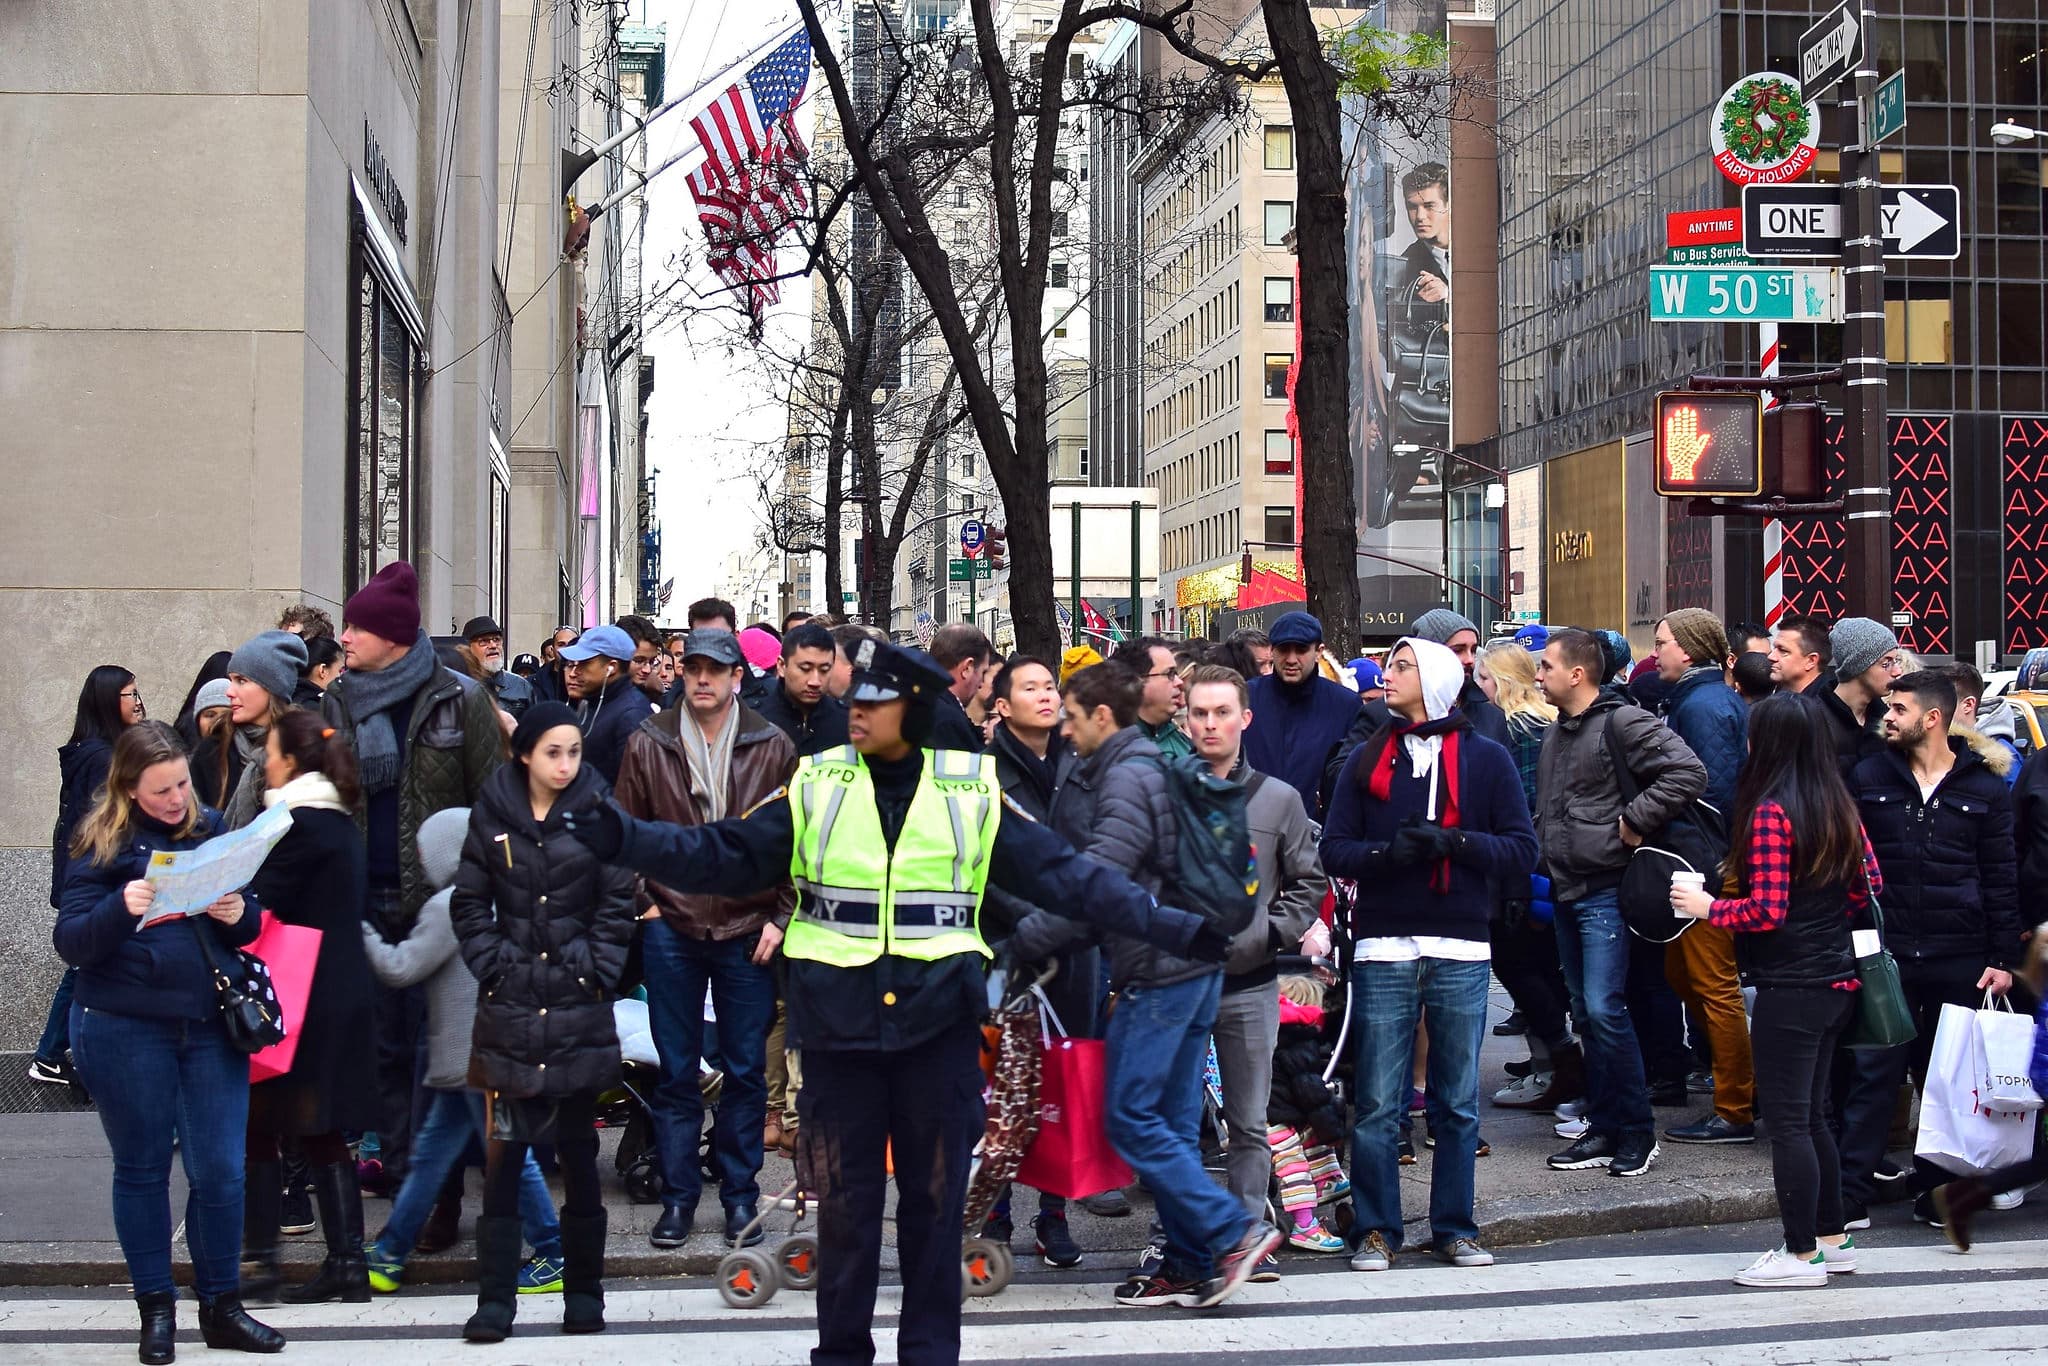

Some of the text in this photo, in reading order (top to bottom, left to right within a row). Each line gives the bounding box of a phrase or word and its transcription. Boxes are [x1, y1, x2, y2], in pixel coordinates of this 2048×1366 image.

[1806, 25, 1845, 79] ONE WAY
[1879, 83, 1897, 133] 5 AV
[1720, 147, 1811, 184] HAPPY HOLIDAYS
[1688, 220, 1734, 234] ANYTIME
[1768, 207, 1826, 234] ONE
[1673, 250, 1686, 261] No
[1689, 248, 1707, 260] Bus
[1659, 274, 1793, 315] W 50 ST
[521, 655, 533, 664] M
[934, 781, 990, 795] NYPD
[934, 906, 970, 927] PD
[1995, 1075, 2031, 1087] TOPM
